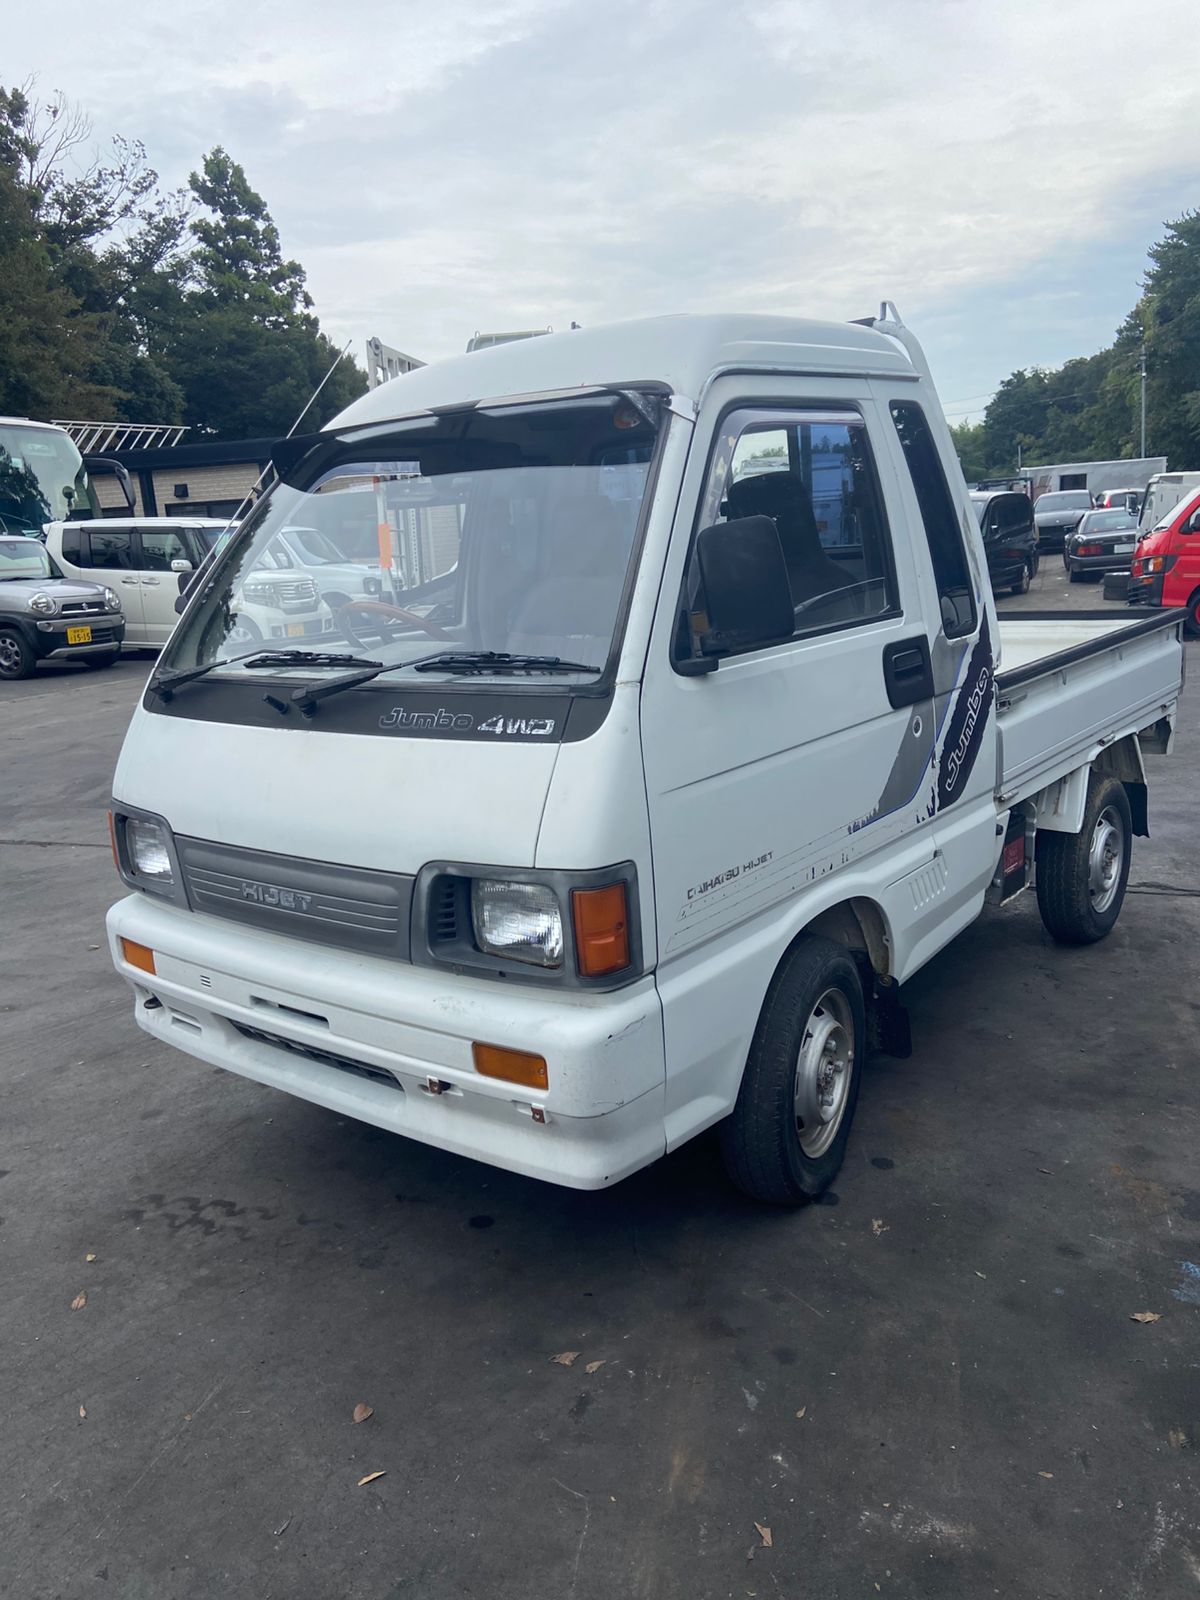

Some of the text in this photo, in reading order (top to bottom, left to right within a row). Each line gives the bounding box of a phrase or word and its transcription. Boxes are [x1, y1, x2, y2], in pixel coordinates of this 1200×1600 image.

[379, 707, 555, 735] Jumbo 4WD
[945, 667, 990, 791] Jumbo
[742, 851, 774, 873] HIJET
[241, 882, 312, 910] HIJET
